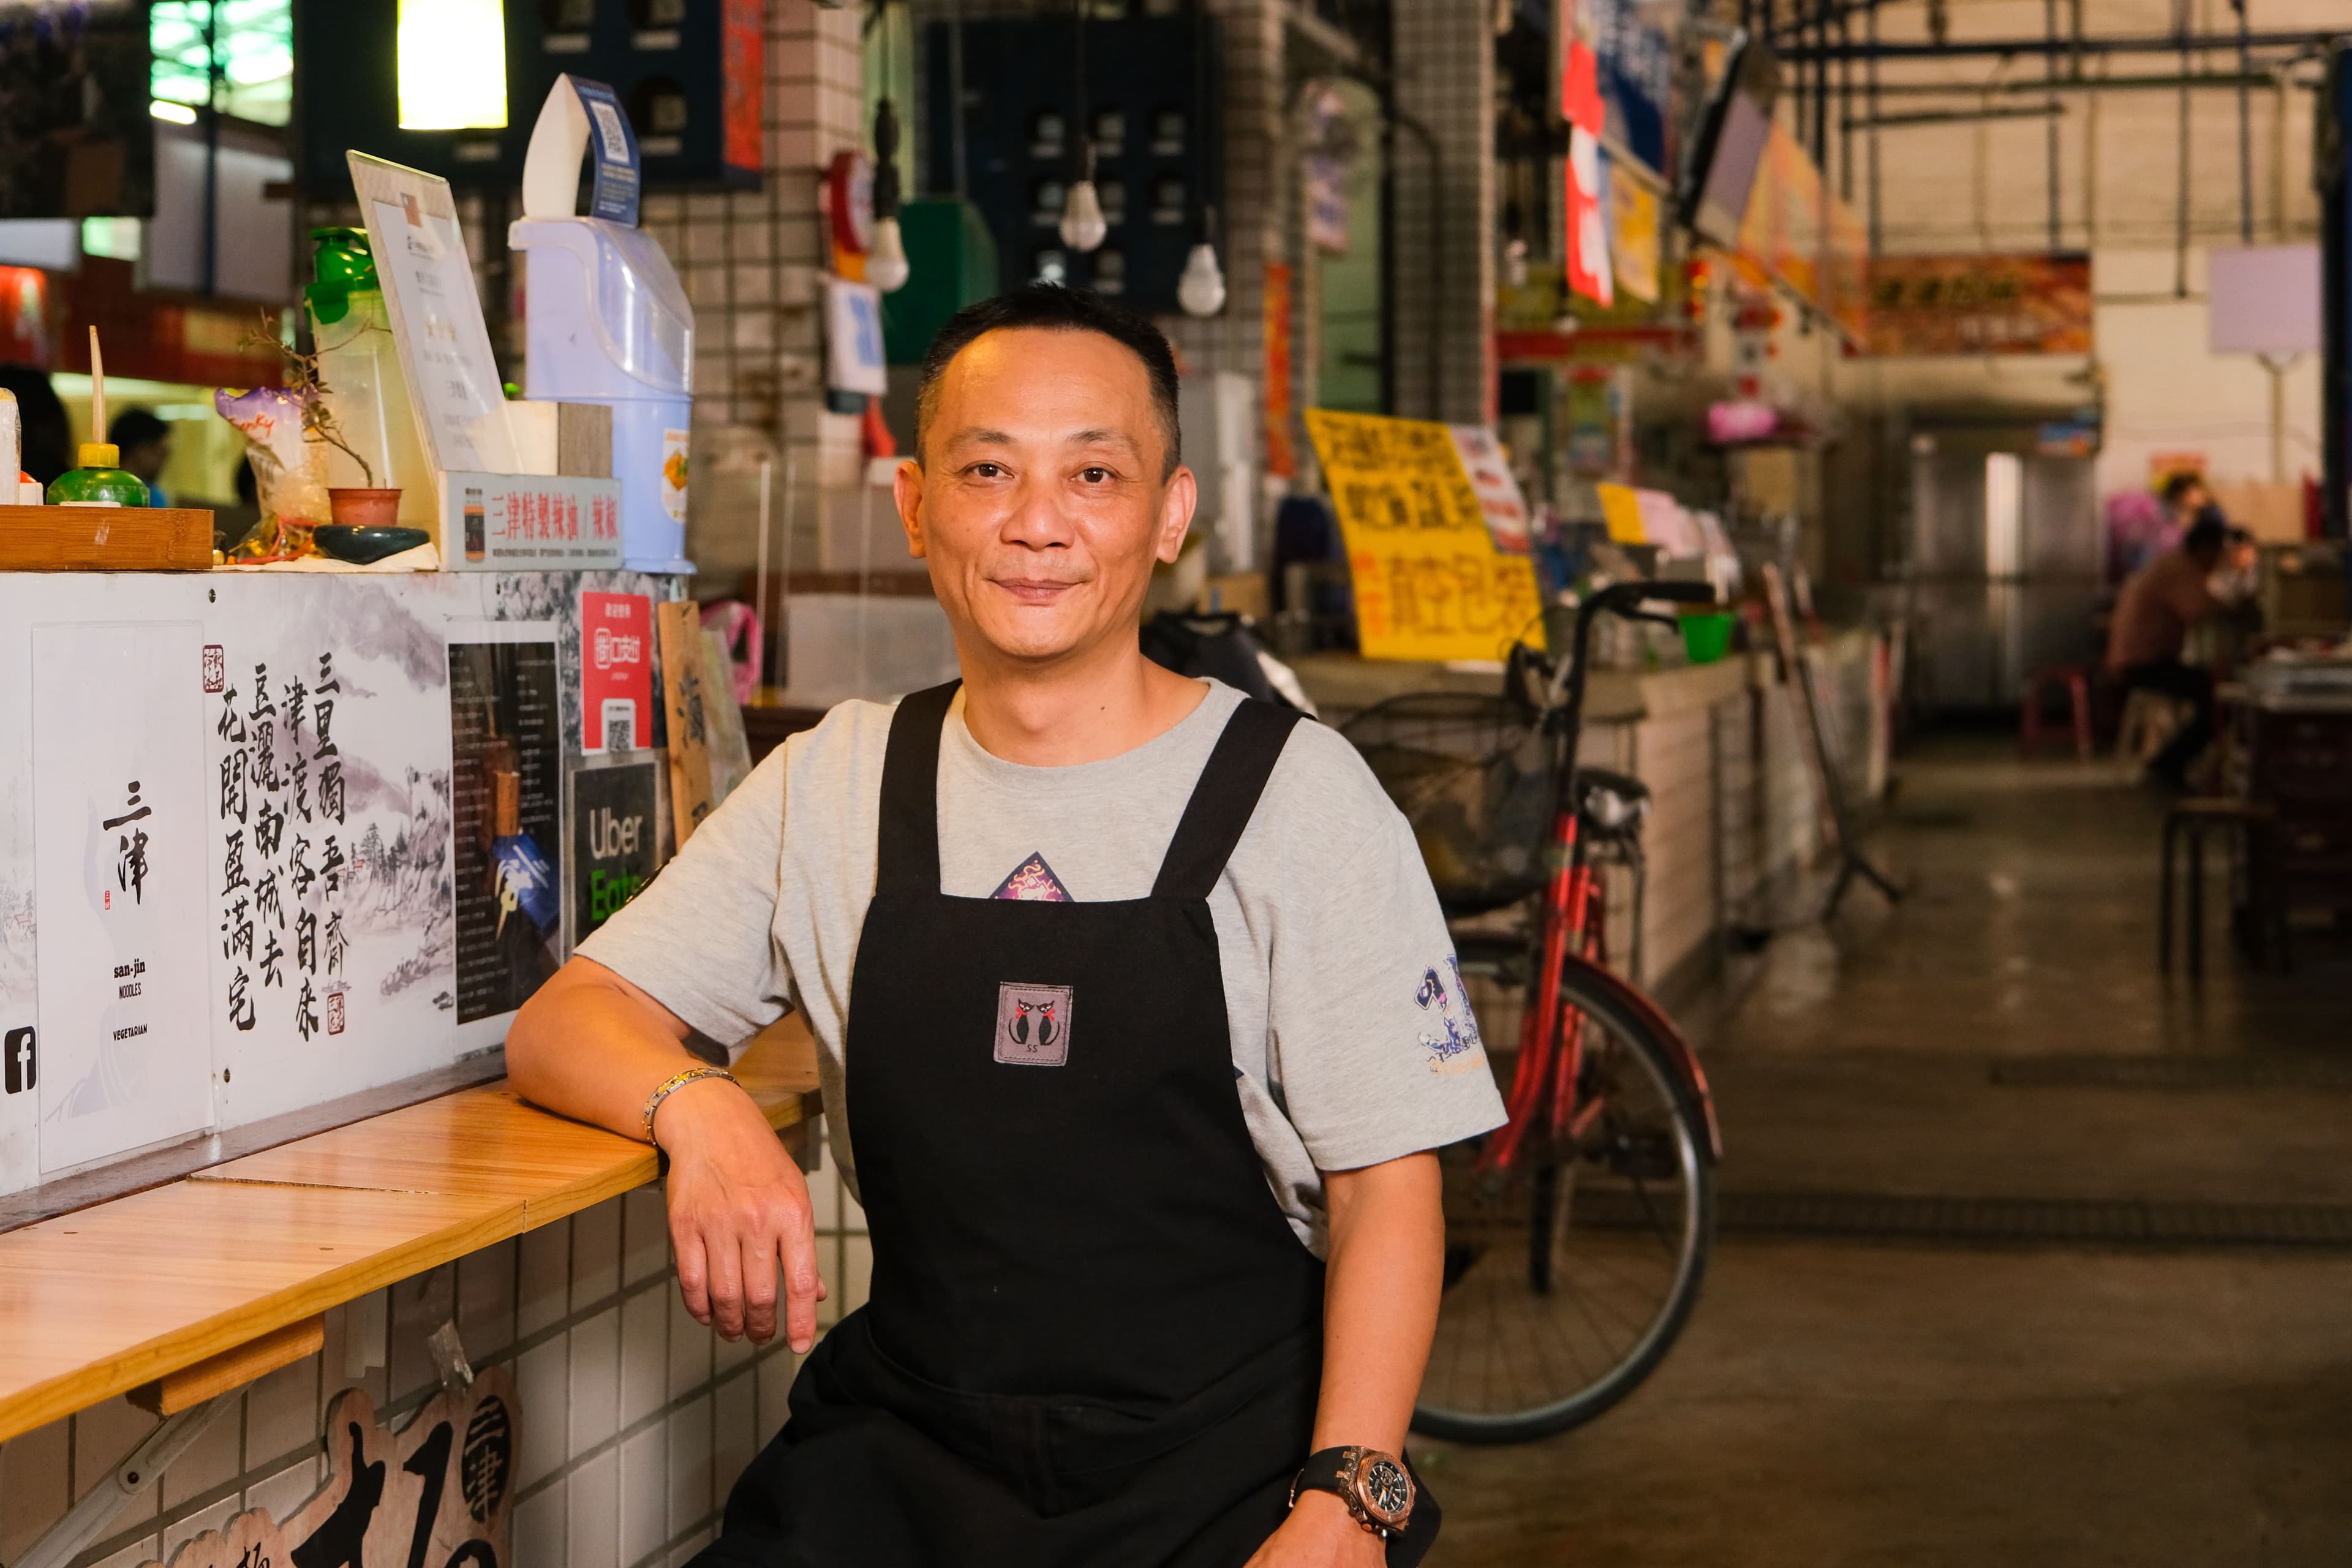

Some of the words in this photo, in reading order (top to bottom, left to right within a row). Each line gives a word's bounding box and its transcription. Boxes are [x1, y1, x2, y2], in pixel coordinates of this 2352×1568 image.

[103, 780, 152, 905] 三津
[590, 807, 643, 860] Uber
[114, 958, 146, 978] san-jin
[119, 982, 141, 1000] NOODLES
[113, 1023, 148, 1041] VEGETARIAN
[464, 1395, 503, 1523] 三津
